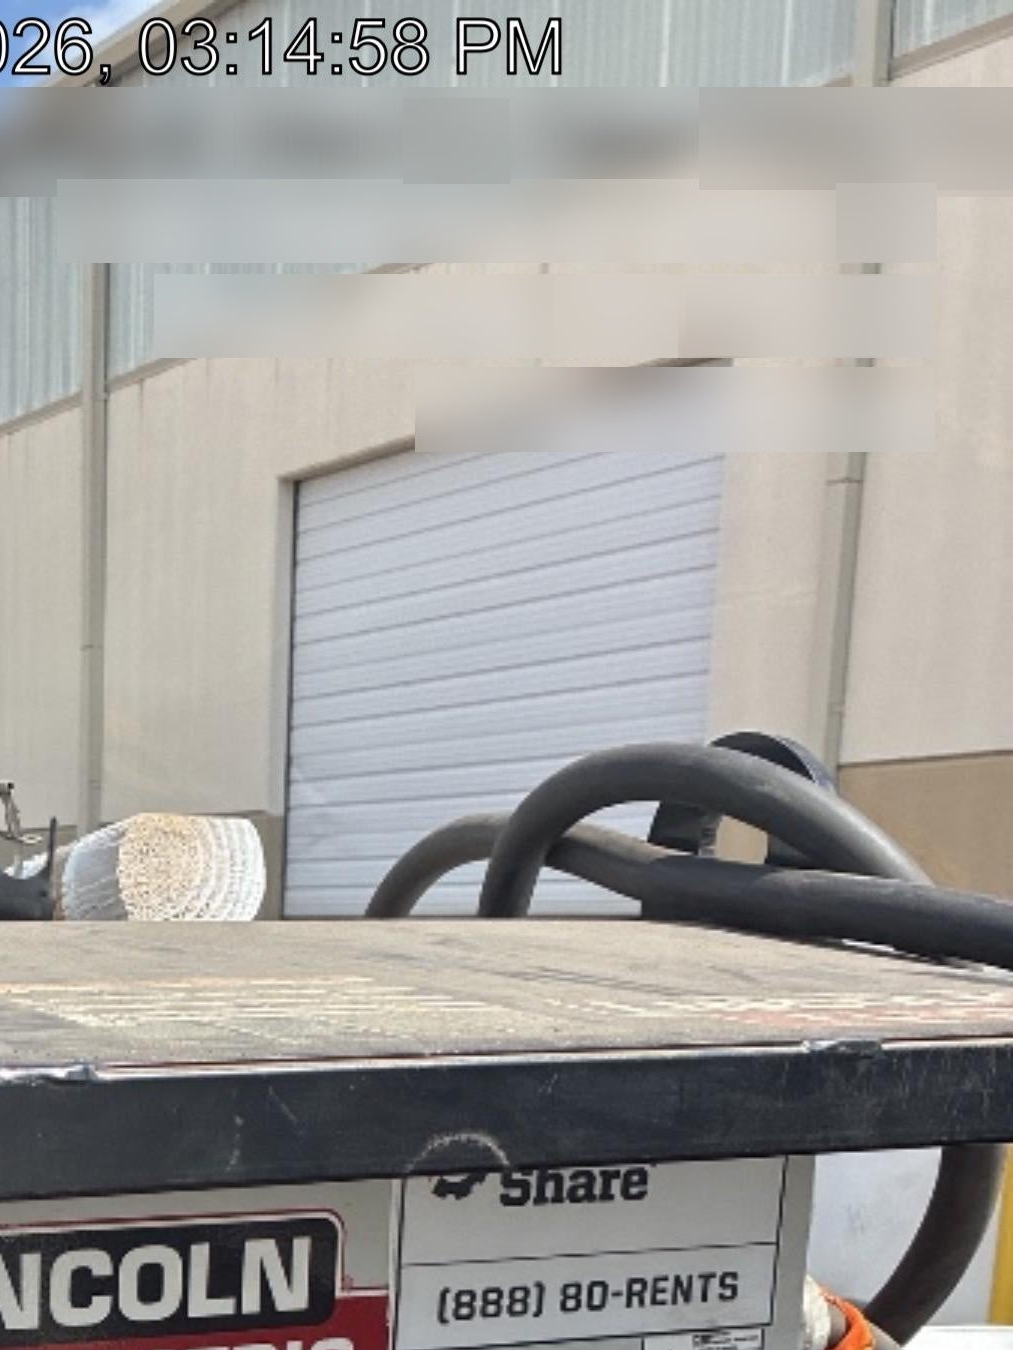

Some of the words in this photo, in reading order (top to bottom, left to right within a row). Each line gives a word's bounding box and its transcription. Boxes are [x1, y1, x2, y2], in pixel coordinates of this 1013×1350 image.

[500, 1164, 649, 1207] Share
[436, 1281, 546, 1325] (888)
[559, 1271, 739, 1314] 80-RENTS
